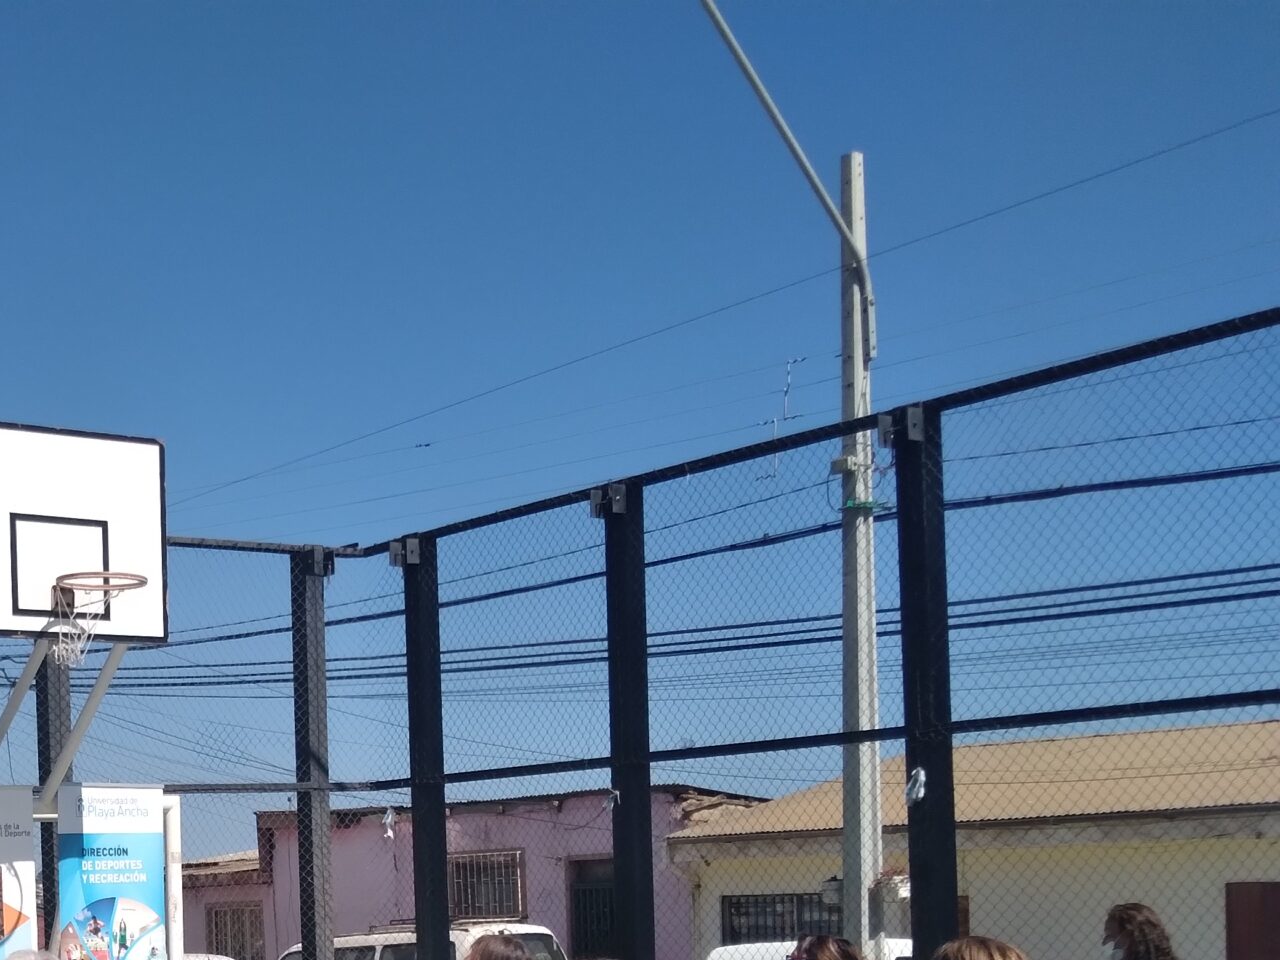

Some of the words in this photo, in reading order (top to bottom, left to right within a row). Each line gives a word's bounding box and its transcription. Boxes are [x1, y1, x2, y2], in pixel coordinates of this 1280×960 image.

[88, 805, 115, 820] Playa
[117, 805, 149, 817] Ancha
[4, 829, 31, 838] Deporte
[82, 845, 129, 857] DIRECCIÓN
[82, 860, 94, 871] DE
[95, 860, 143, 871] DEPORTES
[82, 873, 89, 884] Y
[89, 871, 147, 884] RECREACIÓN
